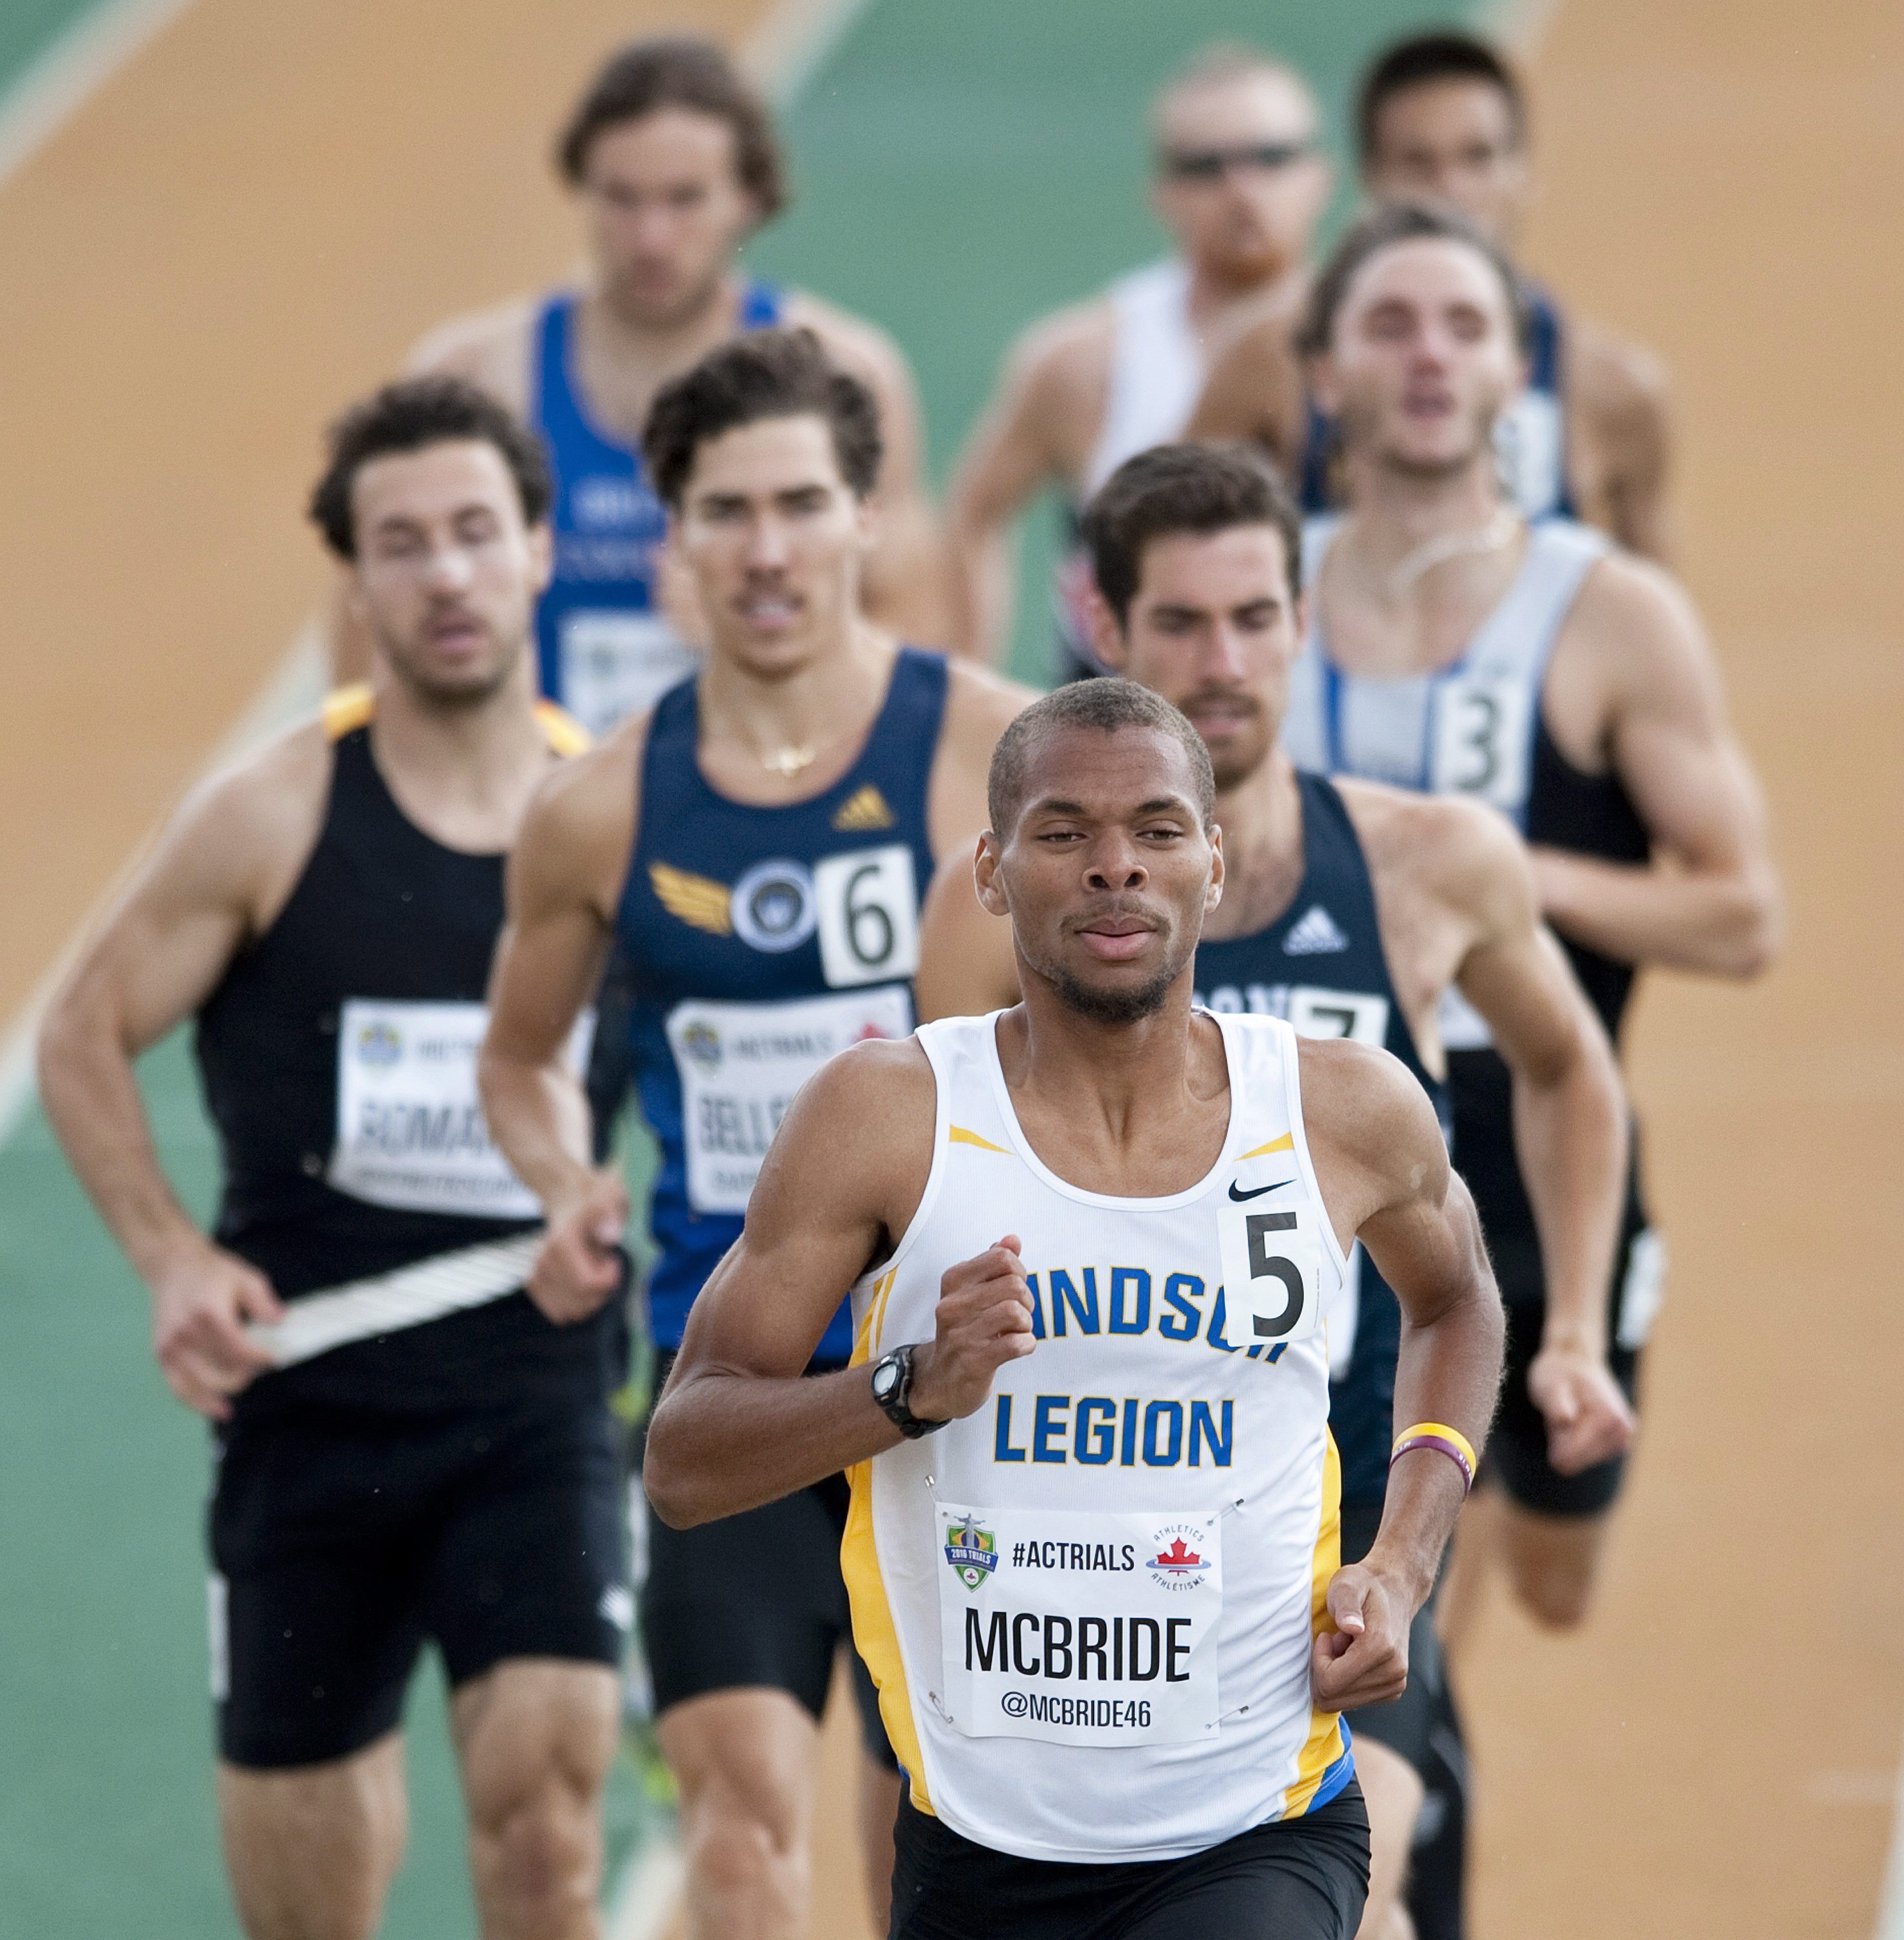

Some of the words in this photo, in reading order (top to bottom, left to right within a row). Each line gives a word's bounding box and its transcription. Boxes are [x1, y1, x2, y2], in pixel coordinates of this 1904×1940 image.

[1456, 693, 1501, 791] 3
[844, 865, 895, 965] 6
[1245, 1211, 1305, 1337] 5
[994, 1393, 1234, 1468] LEGION
[968, 1549, 991, 1564] TRIALS
[1012, 1541, 1135, 1571] #ACTRIALS
[1153, 1524, 1204, 1542] ATHLETICS
[965, 1606, 1192, 1683] MCBRIDE
[1001, 1690, 1151, 1729] @MCBRIDE46
